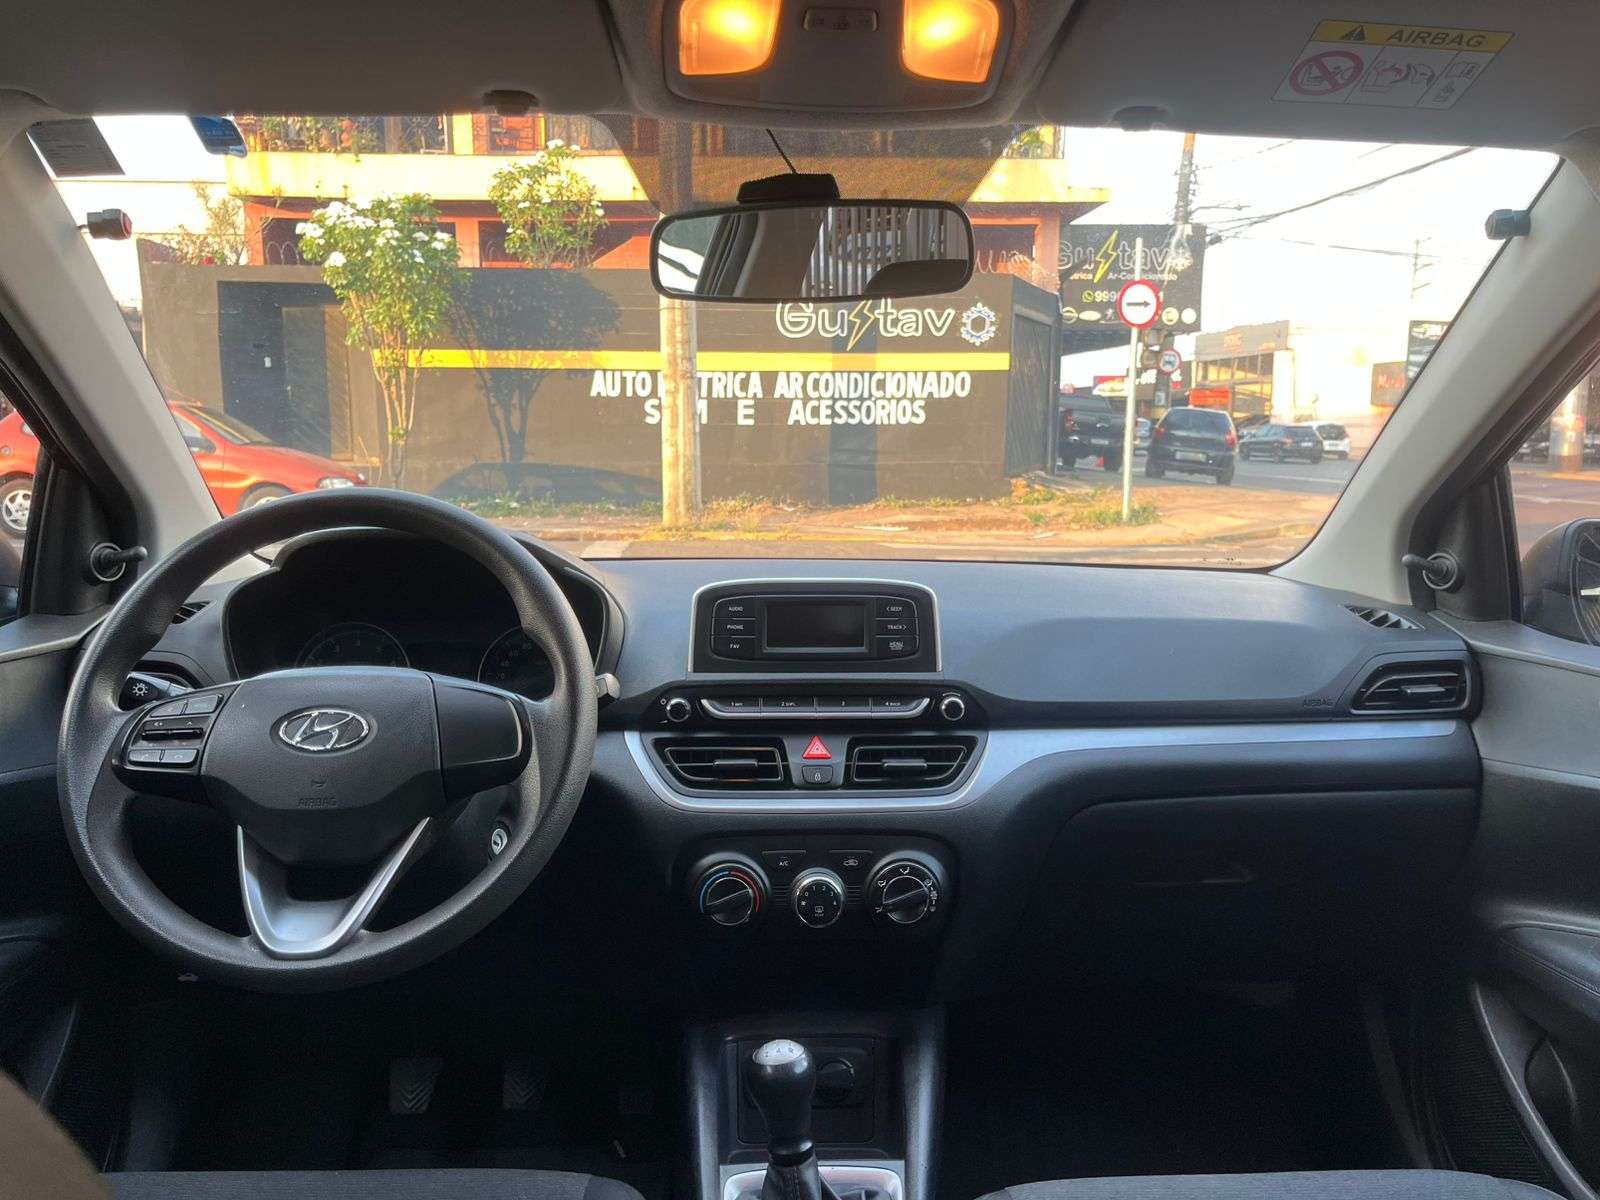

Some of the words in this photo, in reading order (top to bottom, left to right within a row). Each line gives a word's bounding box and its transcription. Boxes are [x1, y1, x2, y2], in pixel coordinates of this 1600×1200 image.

[1386, 29, 1487, 48] AIRBAG
[590, 370, 652, 398] AUTO
[658, 371, 763, 399] TRICA
[774, 371, 804, 399] AR
[806, 371, 972, 399] CONDICIONADO
[737, 400, 755, 425] E
